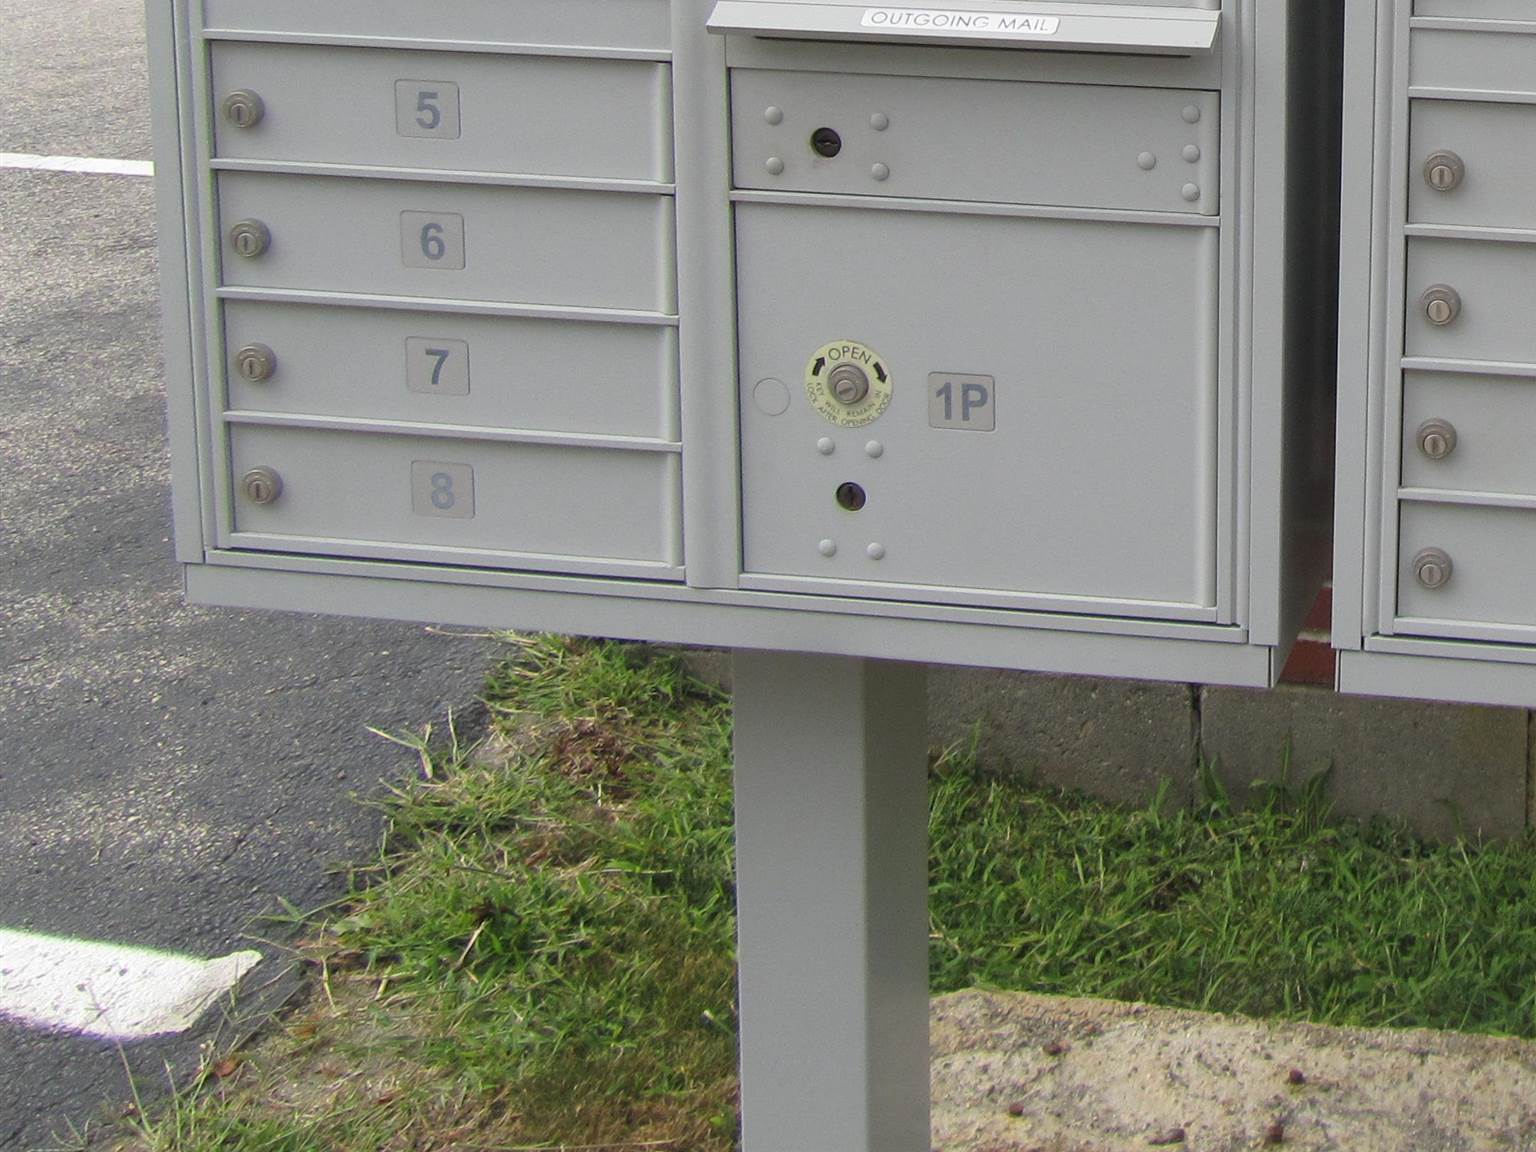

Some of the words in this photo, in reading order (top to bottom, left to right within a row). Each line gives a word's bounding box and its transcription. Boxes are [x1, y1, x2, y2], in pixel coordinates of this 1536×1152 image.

[870, 11, 989, 28] OUTGOING
[998, 17, 1048, 31] MAIL
[416, 92, 440, 130] 5
[420, 223, 445, 260] 6
[425, 349, 448, 385] 7
[828, 346, 872, 364] OPEN
[935, 384, 988, 420] 1P
[430, 473, 454, 509] 8
